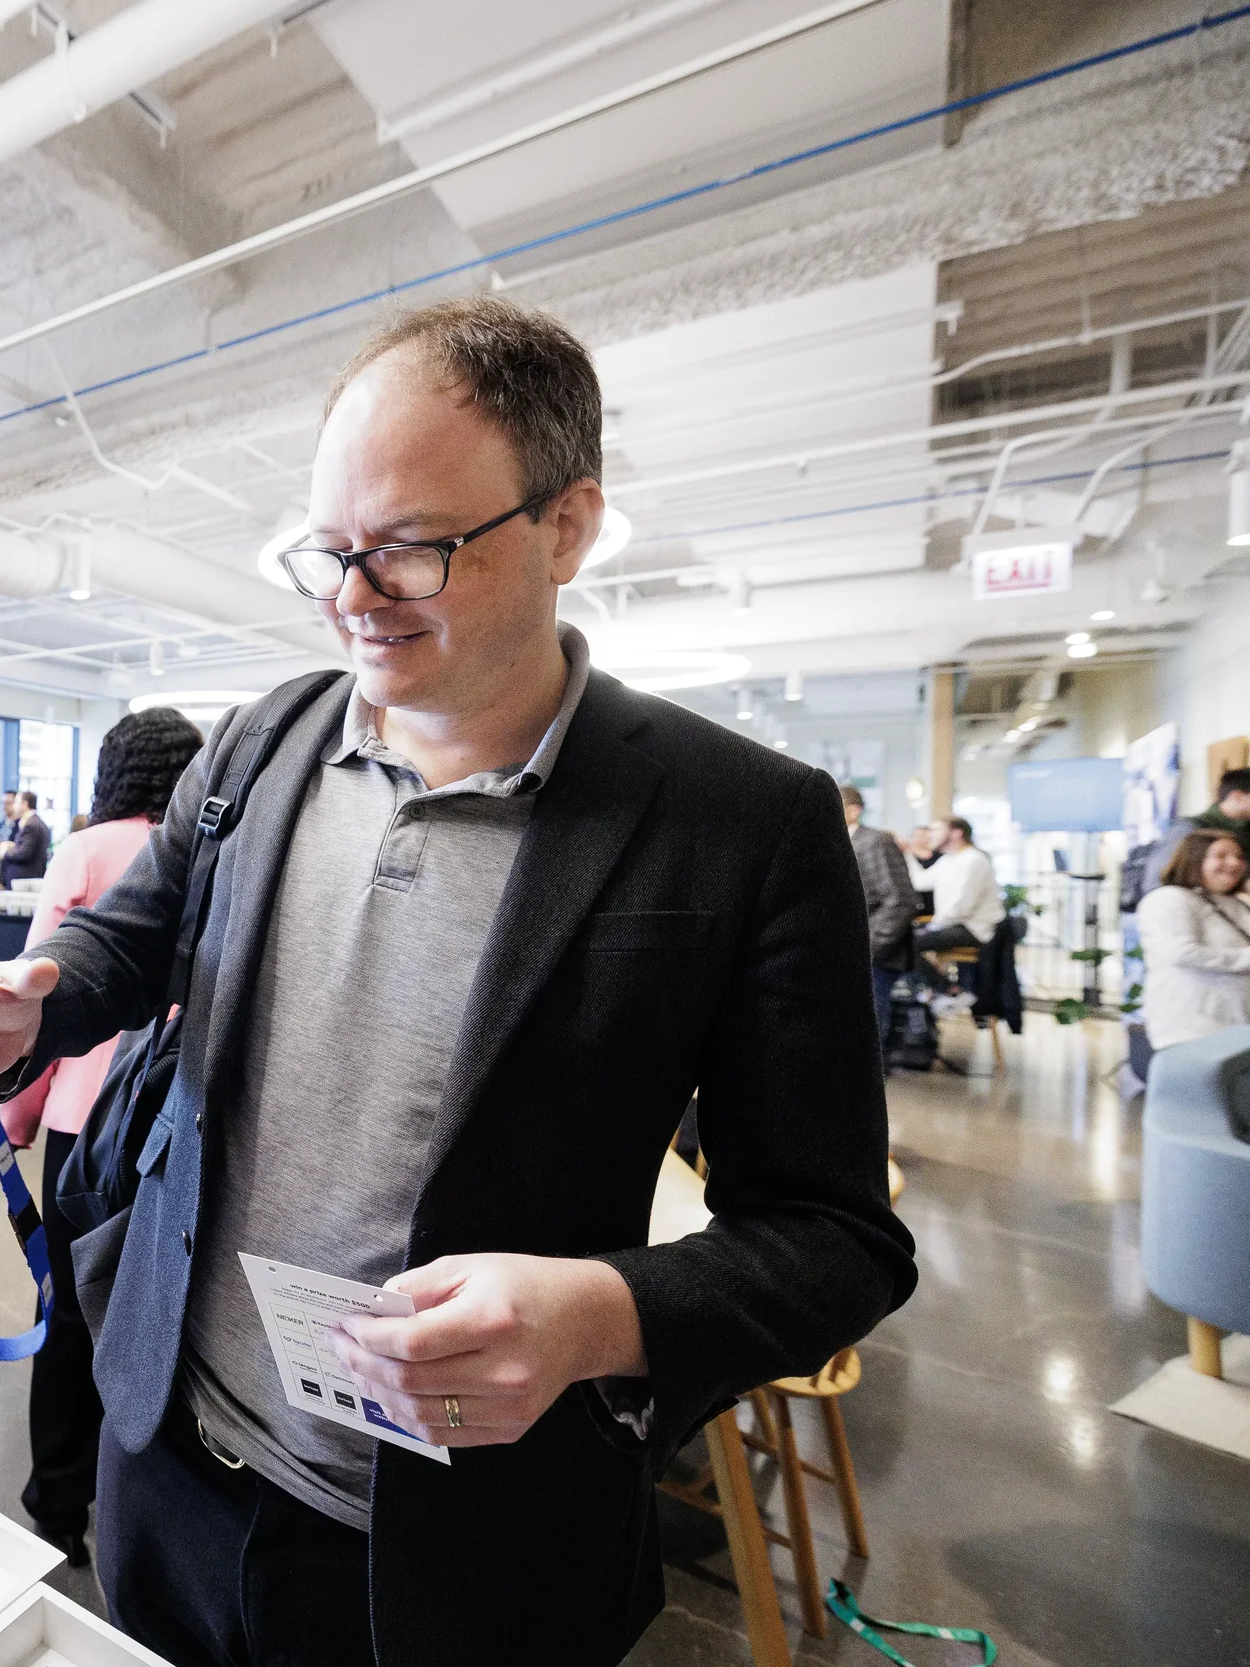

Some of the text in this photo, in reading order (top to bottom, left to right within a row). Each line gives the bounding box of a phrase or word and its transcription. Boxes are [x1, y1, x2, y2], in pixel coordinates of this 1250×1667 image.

[985, 551, 1054, 588] EXIT
[310, 1289, 327, 1298] prize
[328, 1294, 350, 1304] worth
[351, 1300, 370, 1309] $500
